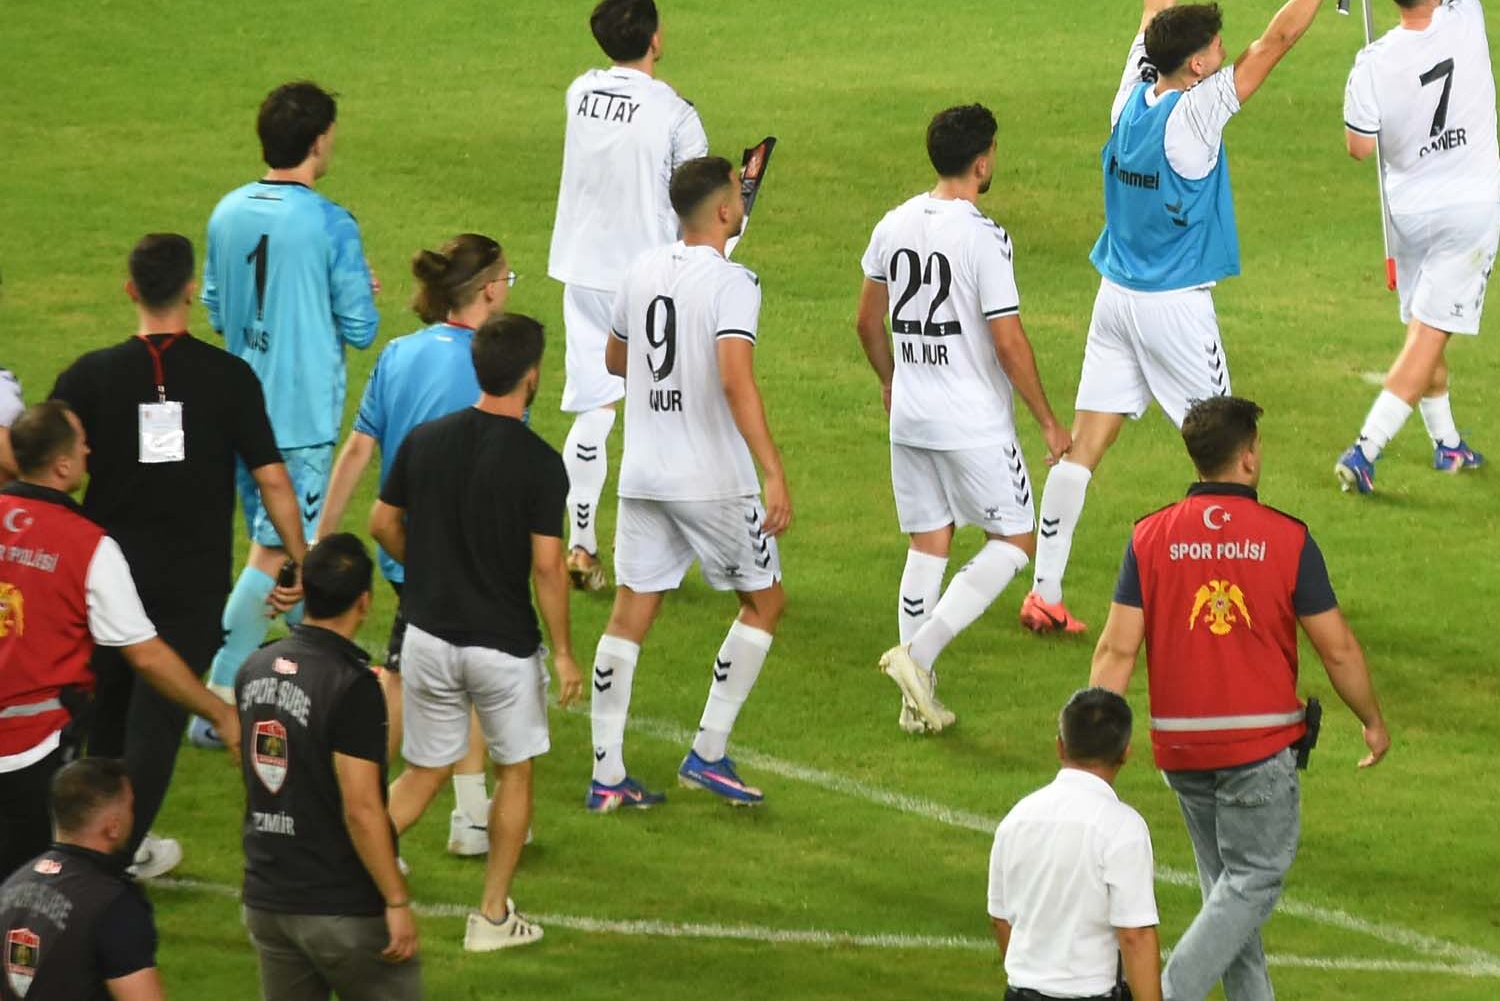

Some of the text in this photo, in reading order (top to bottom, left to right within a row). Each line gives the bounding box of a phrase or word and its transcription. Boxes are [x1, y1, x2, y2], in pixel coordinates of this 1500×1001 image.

[577, 90, 640, 123] ALTAY
[1419, 57, 1455, 137] 7
[1109, 154, 1160, 191] hmmel
[246, 234, 269, 321] 1
[889, 248, 962, 337] 22
[645, 295, 677, 383] 9
[901, 341, 919, 364] M.
[1169, 538, 1266, 561] SPOR POLİSİ
